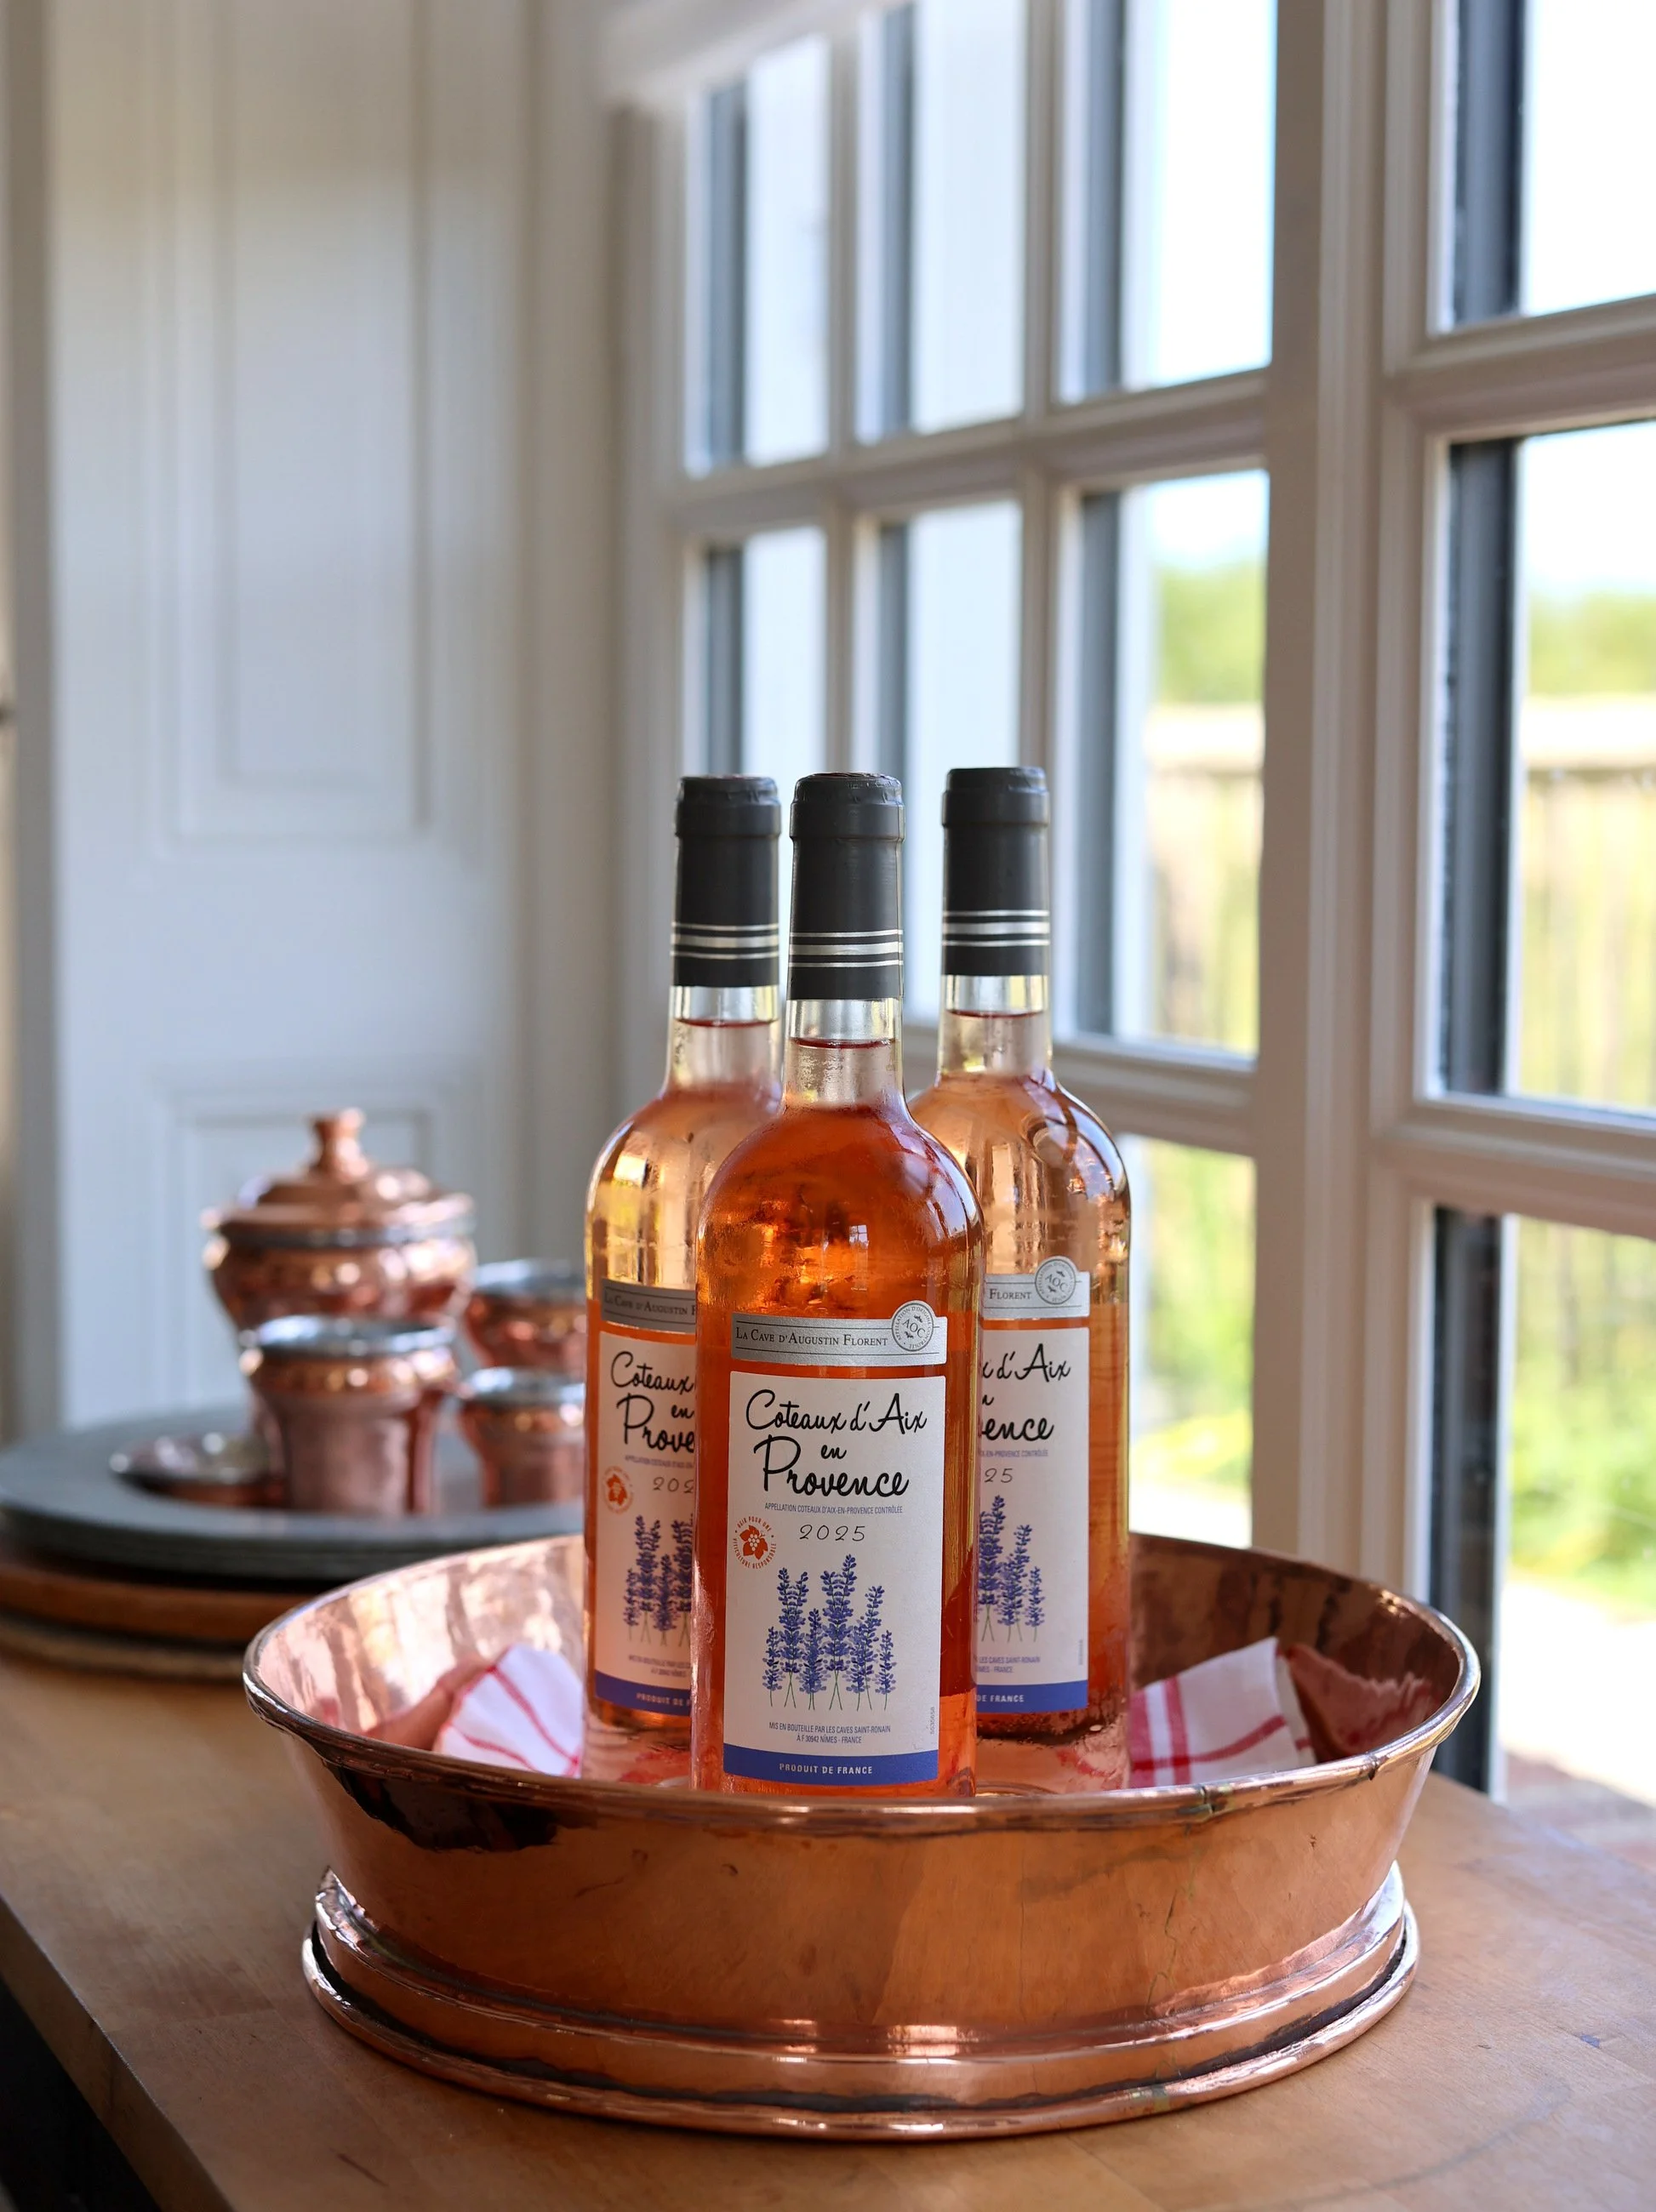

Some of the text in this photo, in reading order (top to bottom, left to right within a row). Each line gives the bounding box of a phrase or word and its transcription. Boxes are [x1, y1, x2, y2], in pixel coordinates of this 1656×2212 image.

[989, 1288, 1031, 1300] FLORENT
[751, 1329, 774, 1343] CAVE
[843, 1334, 888, 1346] FLORENT
[902, 1319, 926, 1338] AOC
[996, 1343, 1071, 1382] d'Aix
[610, 1350, 694, 1395] Coteaux
[745, 1388, 928, 1434] Coteaux d'Aix
[616, 1393, 694, 1453] Prove
[820, 1444, 847, 1460] en
[753, 1434, 910, 1497] Provence
[652, 1476, 694, 1494] 202
[984, 1468, 1014, 1484] 25
[764, 1502, 797, 1512] APPELLATION
[797, 1505, 820, 1514] COTEAUX
[821, 1505, 874, 1514] D'AIX-EN-PROVENCE
[799, 1524, 865, 1542] 2025
[787, 1724, 814, 1733] BOUTEILLE
[814, 1725, 825, 1734] PAR
[825, 1725, 836, 1734] LES
[837, 1725, 854, 1734] CAVES
[779, 1763, 819, 1774] PRODUIT
[837, 1766, 873, 1775] FRANCE
